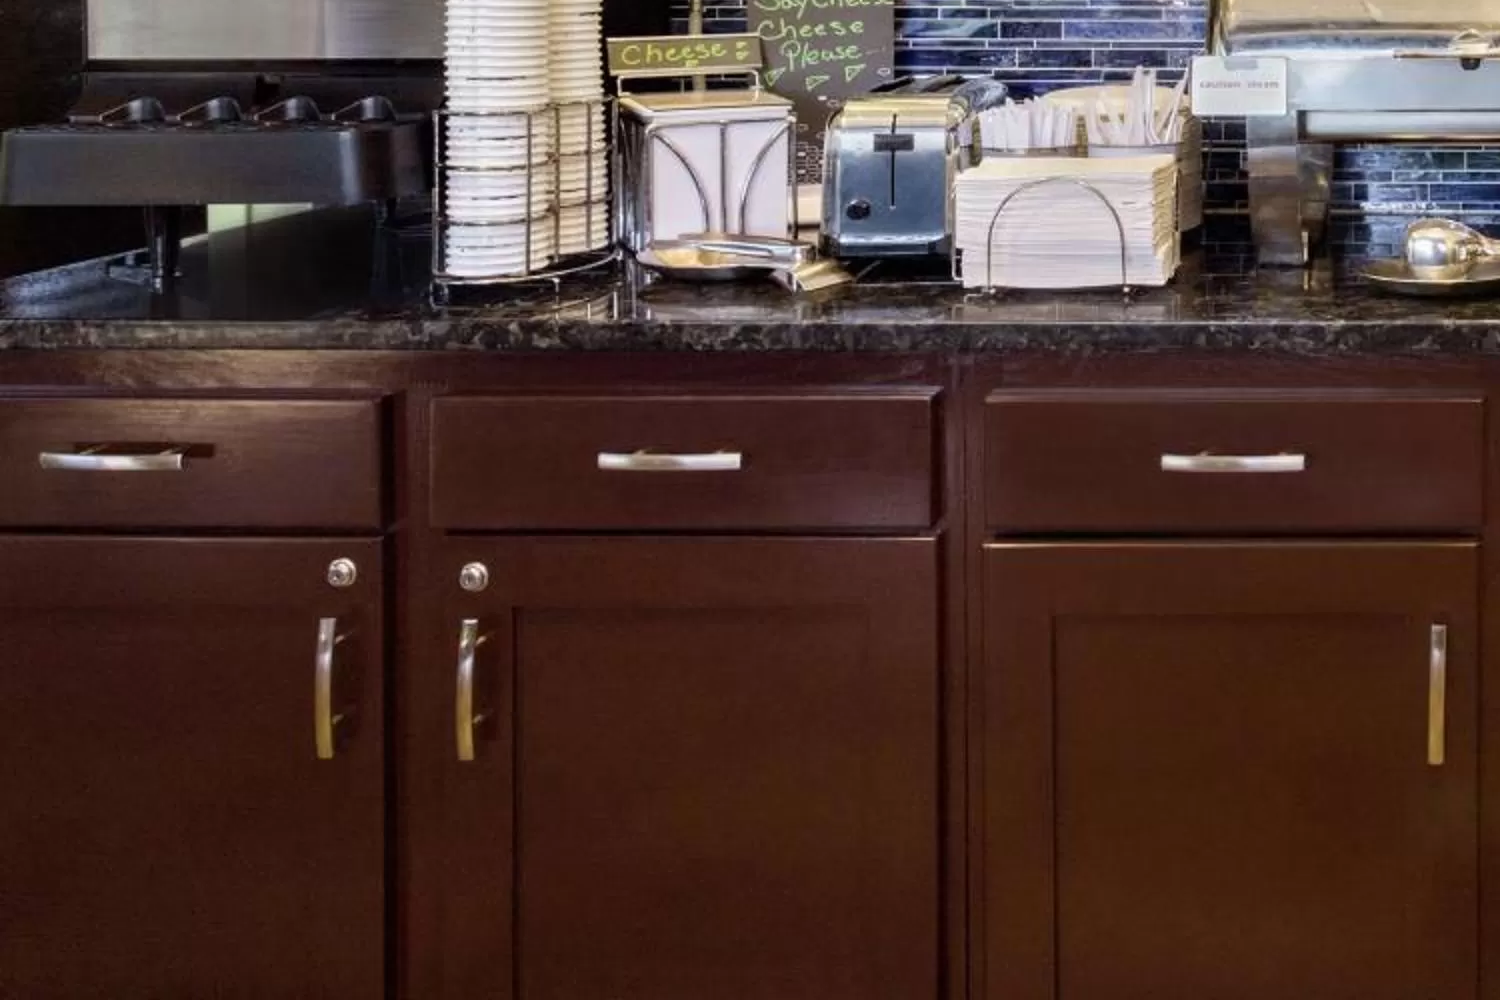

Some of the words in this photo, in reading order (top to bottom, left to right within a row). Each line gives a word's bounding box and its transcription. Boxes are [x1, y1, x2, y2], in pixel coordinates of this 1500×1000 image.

[757, 17, 865, 41] Cheese
[621, 42, 727, 65] Cheese
[780, 39, 862, 72] Please
